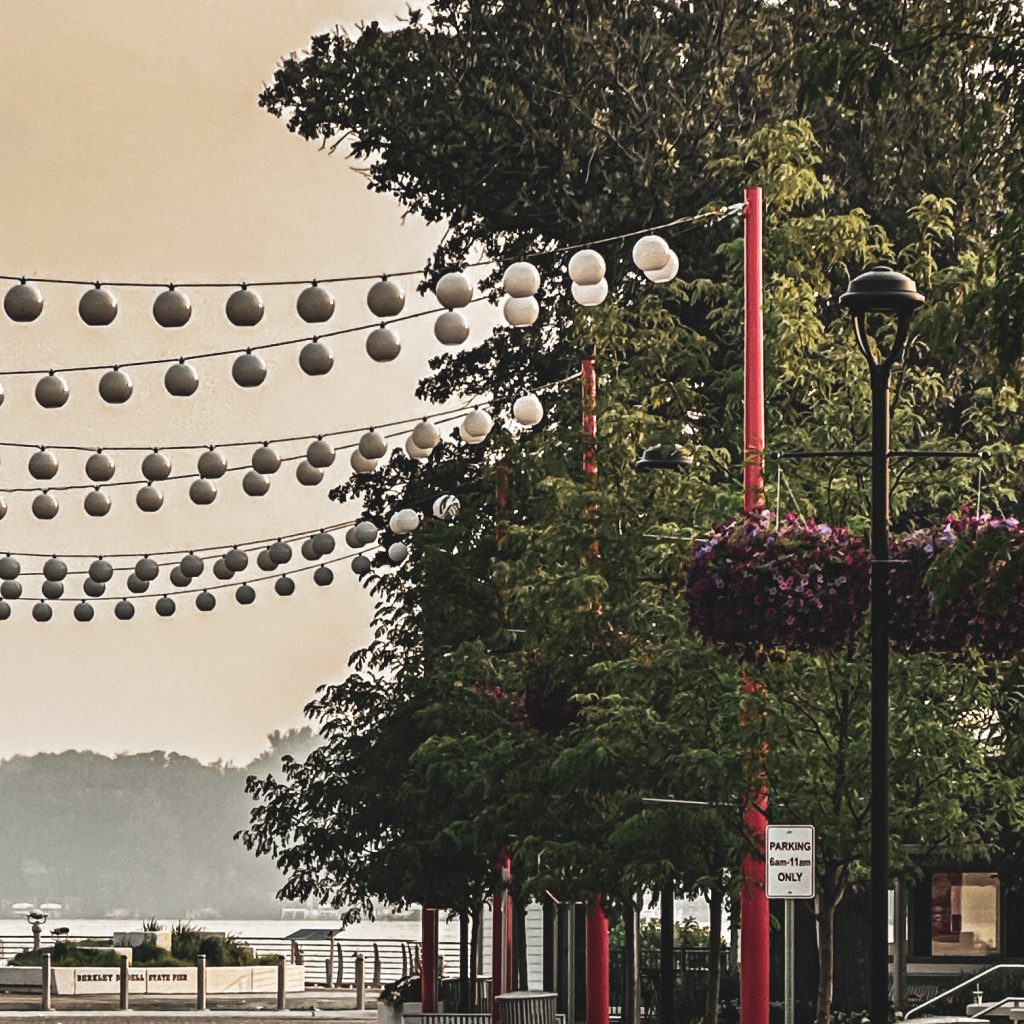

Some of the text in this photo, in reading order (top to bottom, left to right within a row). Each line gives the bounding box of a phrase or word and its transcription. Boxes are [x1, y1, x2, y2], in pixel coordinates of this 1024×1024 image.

[770, 842, 811, 851] PARKING
[770, 857, 811, 866] 6am-11am
[778, 872, 803, 882] ONLY
[77, 974, 113, 982] BERKLEY
